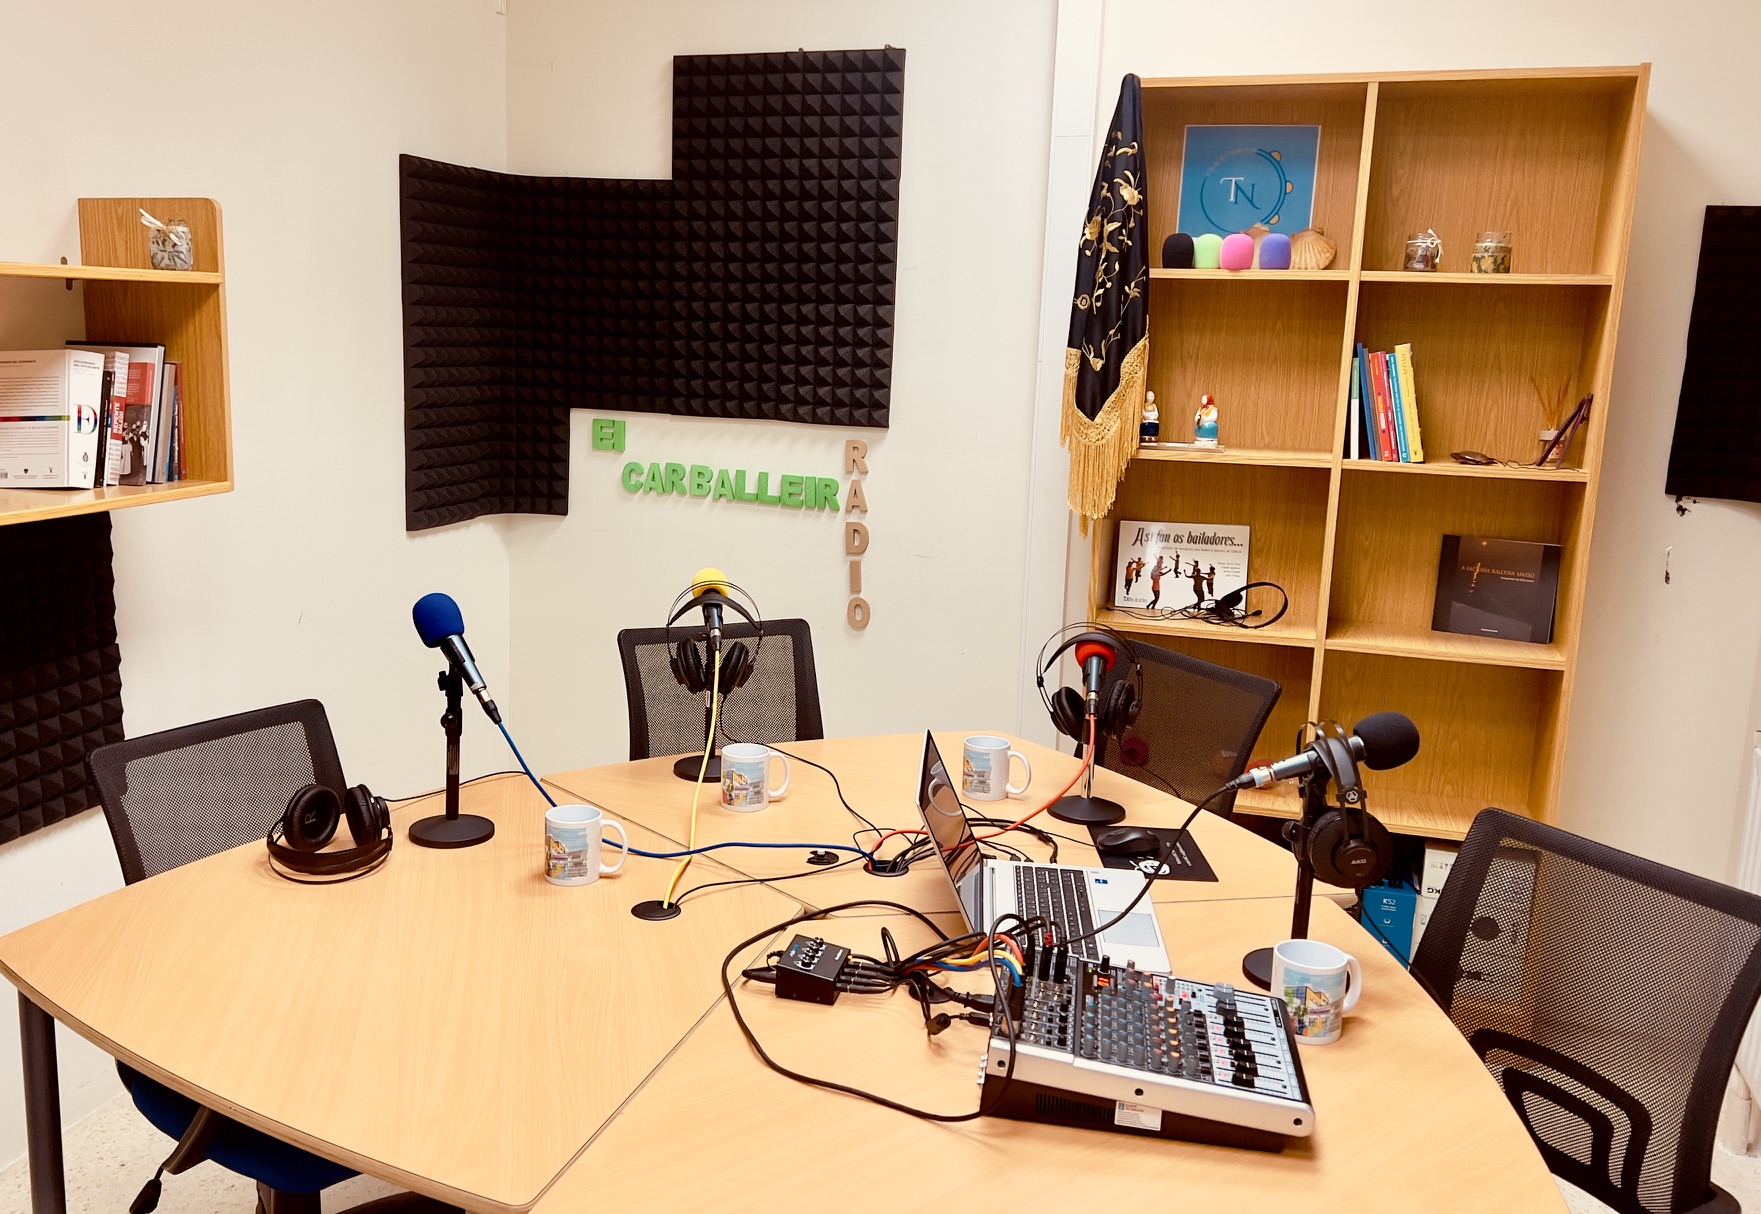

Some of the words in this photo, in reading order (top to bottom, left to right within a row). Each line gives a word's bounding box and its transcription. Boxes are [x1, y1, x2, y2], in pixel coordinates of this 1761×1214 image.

[1220, 176, 1262, 210] TN
[621, 461, 841, 511] CARBALLEIR
[845, 439, 871, 629] RADIO
[1173, 532, 1185, 544] os
